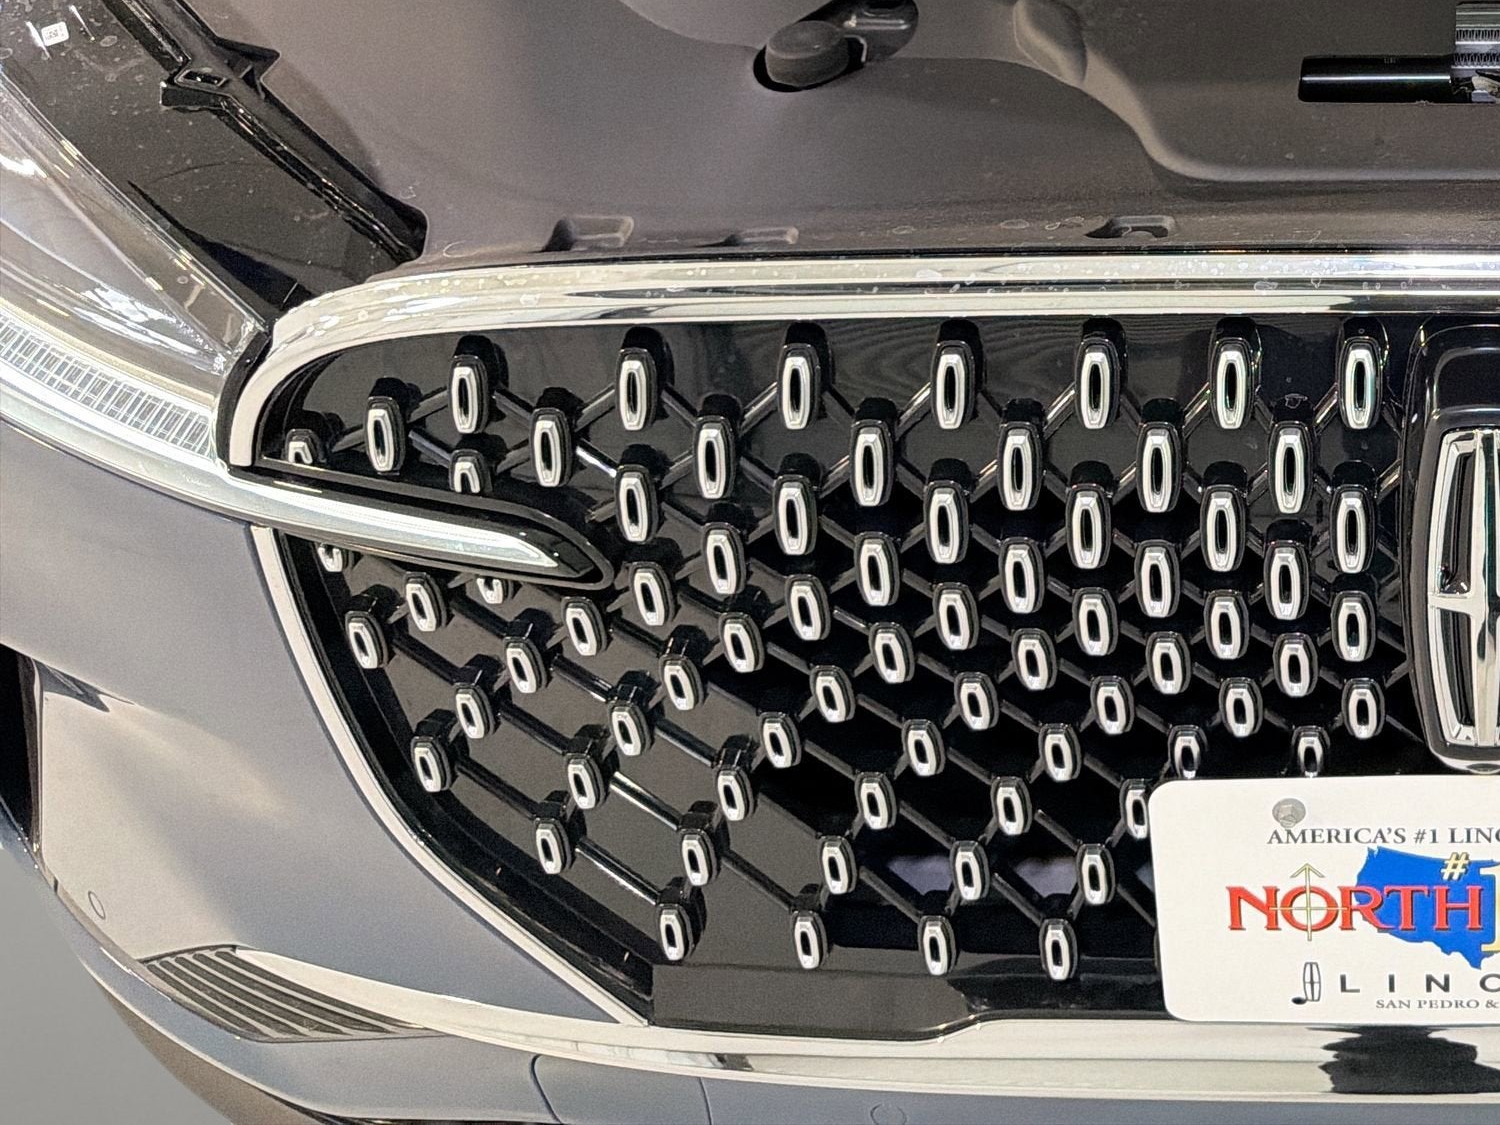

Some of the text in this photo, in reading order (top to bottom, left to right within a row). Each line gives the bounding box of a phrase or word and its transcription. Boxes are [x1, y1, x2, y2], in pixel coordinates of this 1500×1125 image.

[1266, 827, 1407, 845] AMERICA'S
[1413, 828, 1440, 845] #1
[1226, 884, 1484, 932] NORTH
[1376, 999, 1411, 1009] SAN
[1417, 999, 1480, 1009] PEDRO
[1485, 999, 1499, 1009] &
